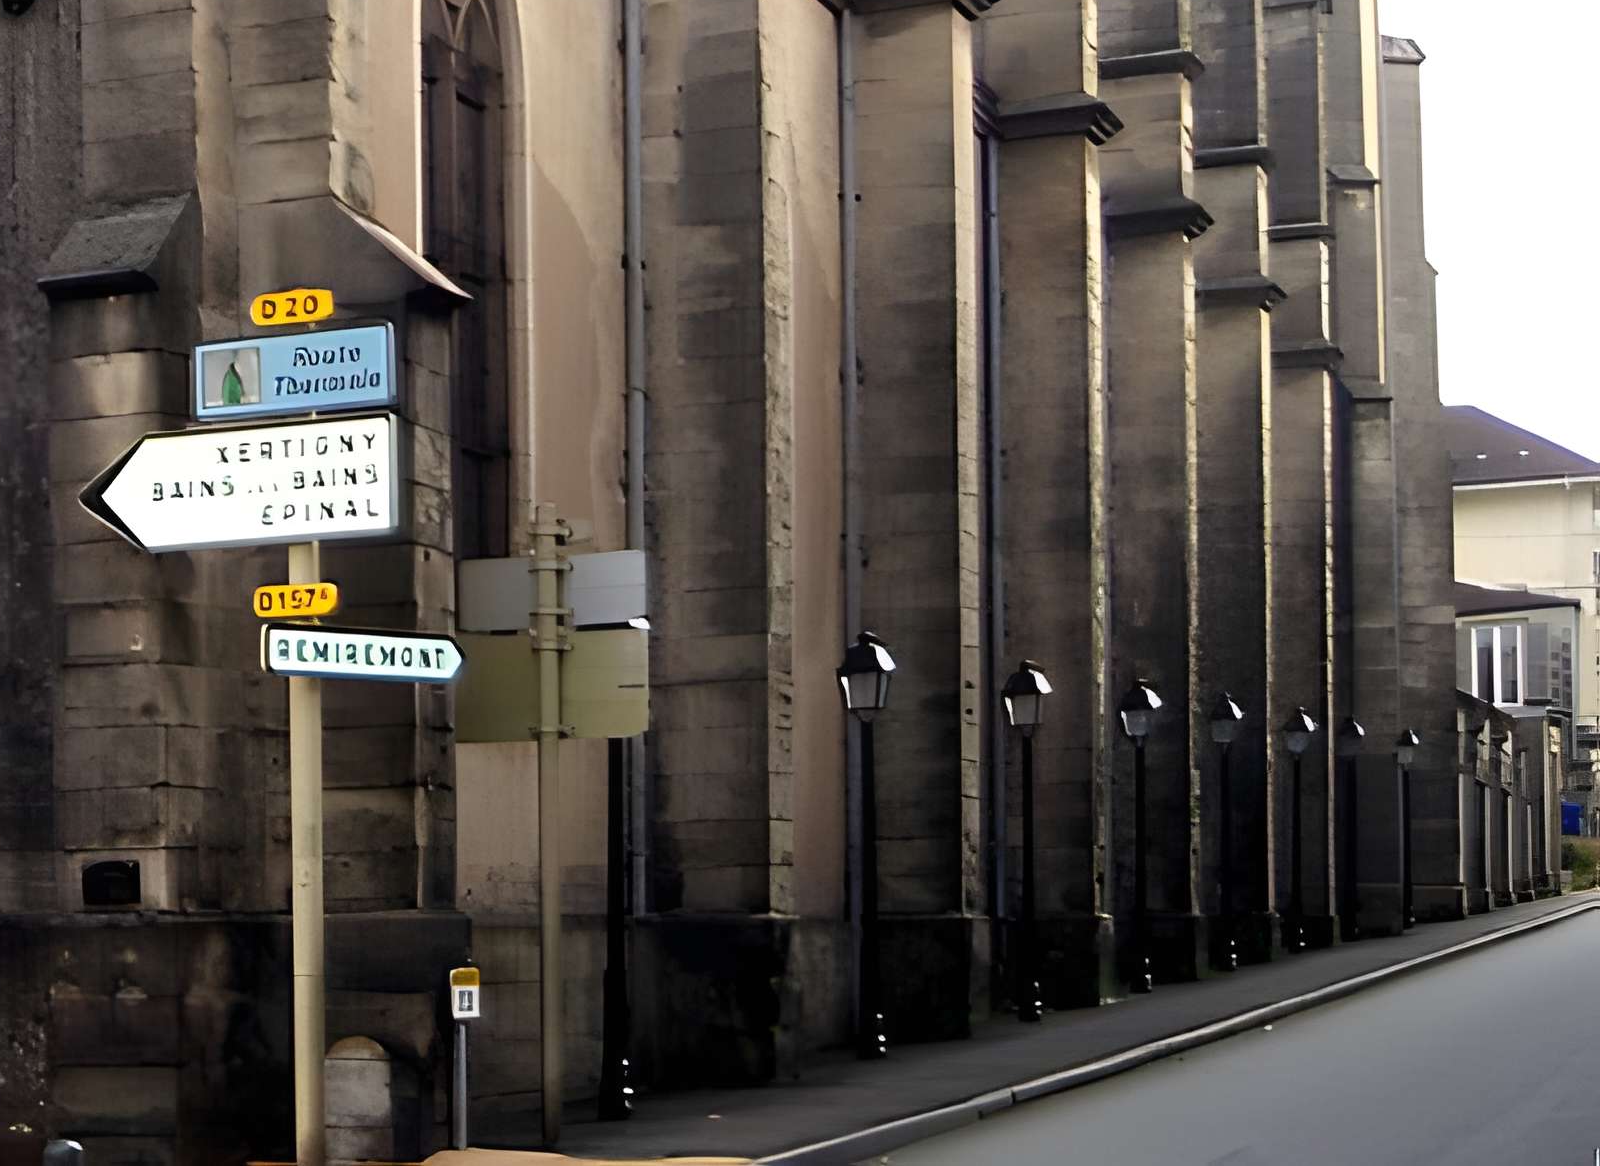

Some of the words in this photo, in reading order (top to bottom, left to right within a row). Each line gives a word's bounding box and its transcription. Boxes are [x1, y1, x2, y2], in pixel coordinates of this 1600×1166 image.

[285, 295, 319, 317] 20
[152, 475, 234, 501] BAINS
[293, 463, 378, 489] BAINS
